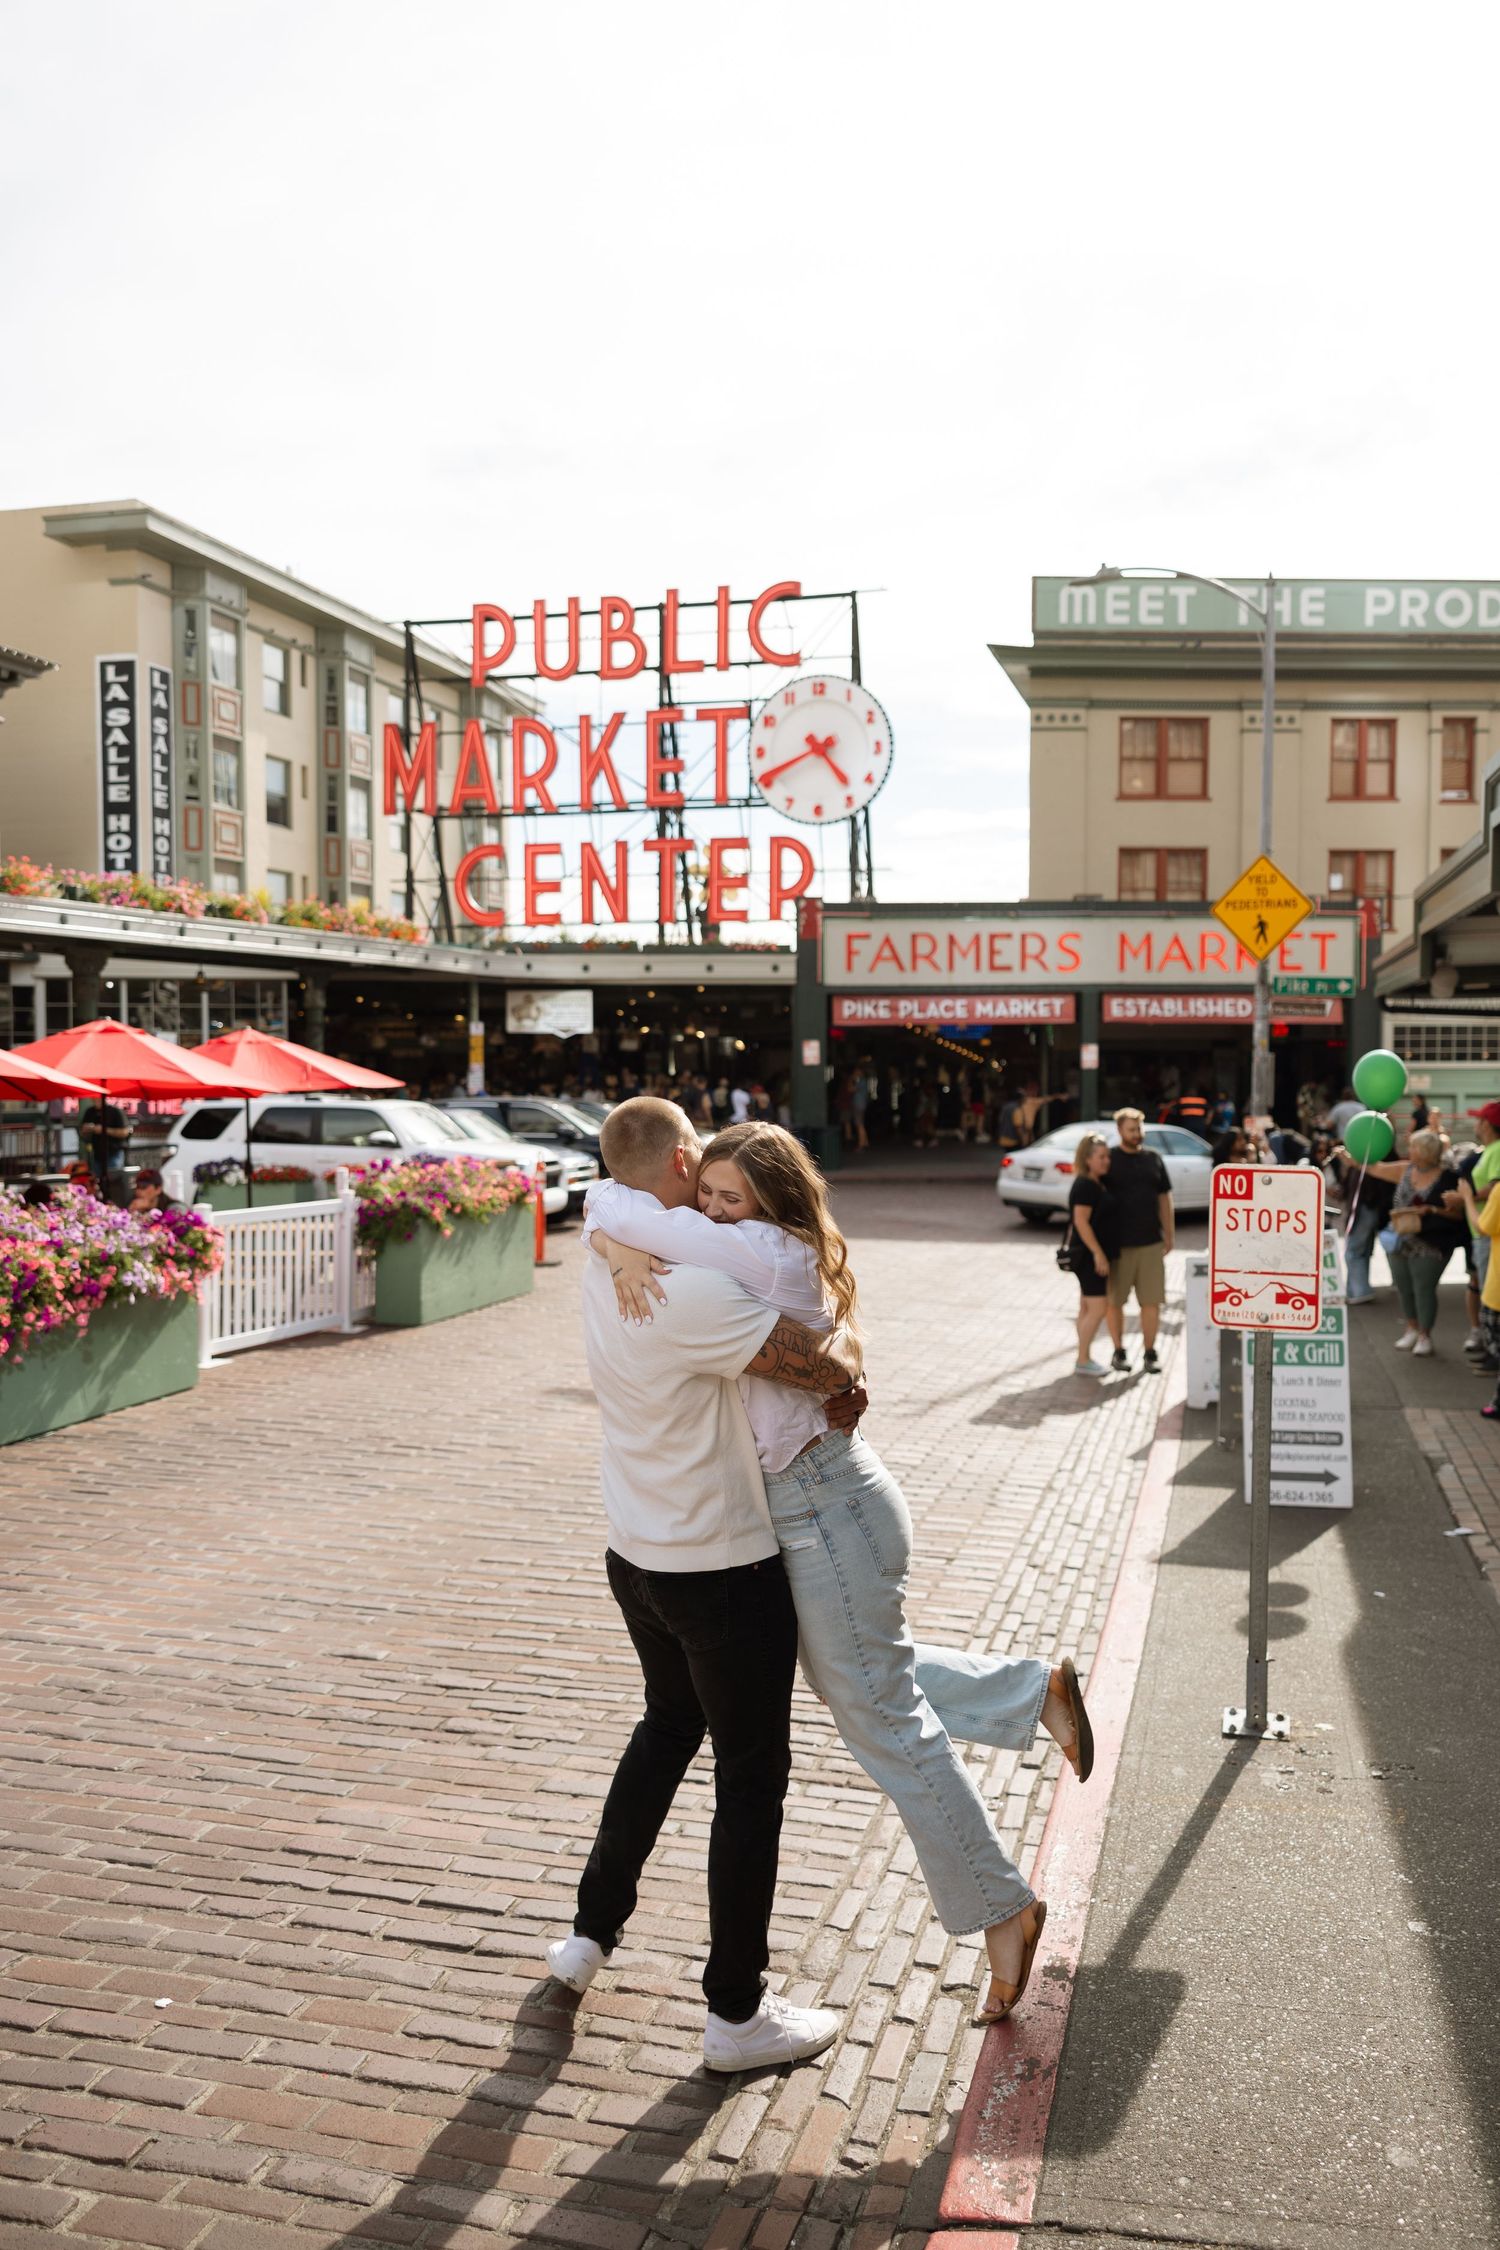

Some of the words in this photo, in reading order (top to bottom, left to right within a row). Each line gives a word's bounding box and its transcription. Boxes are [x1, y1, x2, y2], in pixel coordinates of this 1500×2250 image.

[1058, 584, 1197, 627] MEET
[471, 580, 803, 688] PUBLIC
[104, 664, 130, 702] LA
[151, 669, 168, 710] LA
[812, 681, 827, 697] 12
[784, 691, 796, 706] 11
[846, 688, 852, 704] 1
[763, 714, 777, 729] 10
[866, 710, 875, 725] 2
[105, 707, 132, 804] SALLE
[756, 745, 766, 760] 9
[874, 740, 882, 756] 3
[152, 716, 170, 810] SALLE
[383, 704, 751, 817] MARKET
[863, 772, 874, 785] 4
[785, 796, 795, 811] 7
[845, 794, 854, 809] 5
[813, 803, 823, 817] 6
[453, 835, 817, 928] CENTER
[1247, 874, 1278, 886] YIELD
[1256, 886, 1269, 898] TO
[1224, 898, 1299, 912] PEDESTRIANS
[844, 931, 1083, 974] FARMERS
[1277, 977, 1310, 994] Pike
[841, 997, 892, 1020] PIKE
[897, 997, 969, 1020] PLACE
[974, 996, 1066, 1020] MARKET
[1110, 996, 1253, 1020] ESTABLISHED
[1218, 1173, 1248, 1197] NO
[1225, 1206, 1308, 1235] STOPS
[1283, 1341, 1300, 1364] &
[1303, 1342, 1341, 1365] Grill
[1281, 1375, 1305, 1388] Lunch
[1316, 1375, 1342, 1389] Dinner
[1273, 1398, 1318, 1409] COCKTAILS
[1308, 1412, 1346, 1424] SEAFOOD
